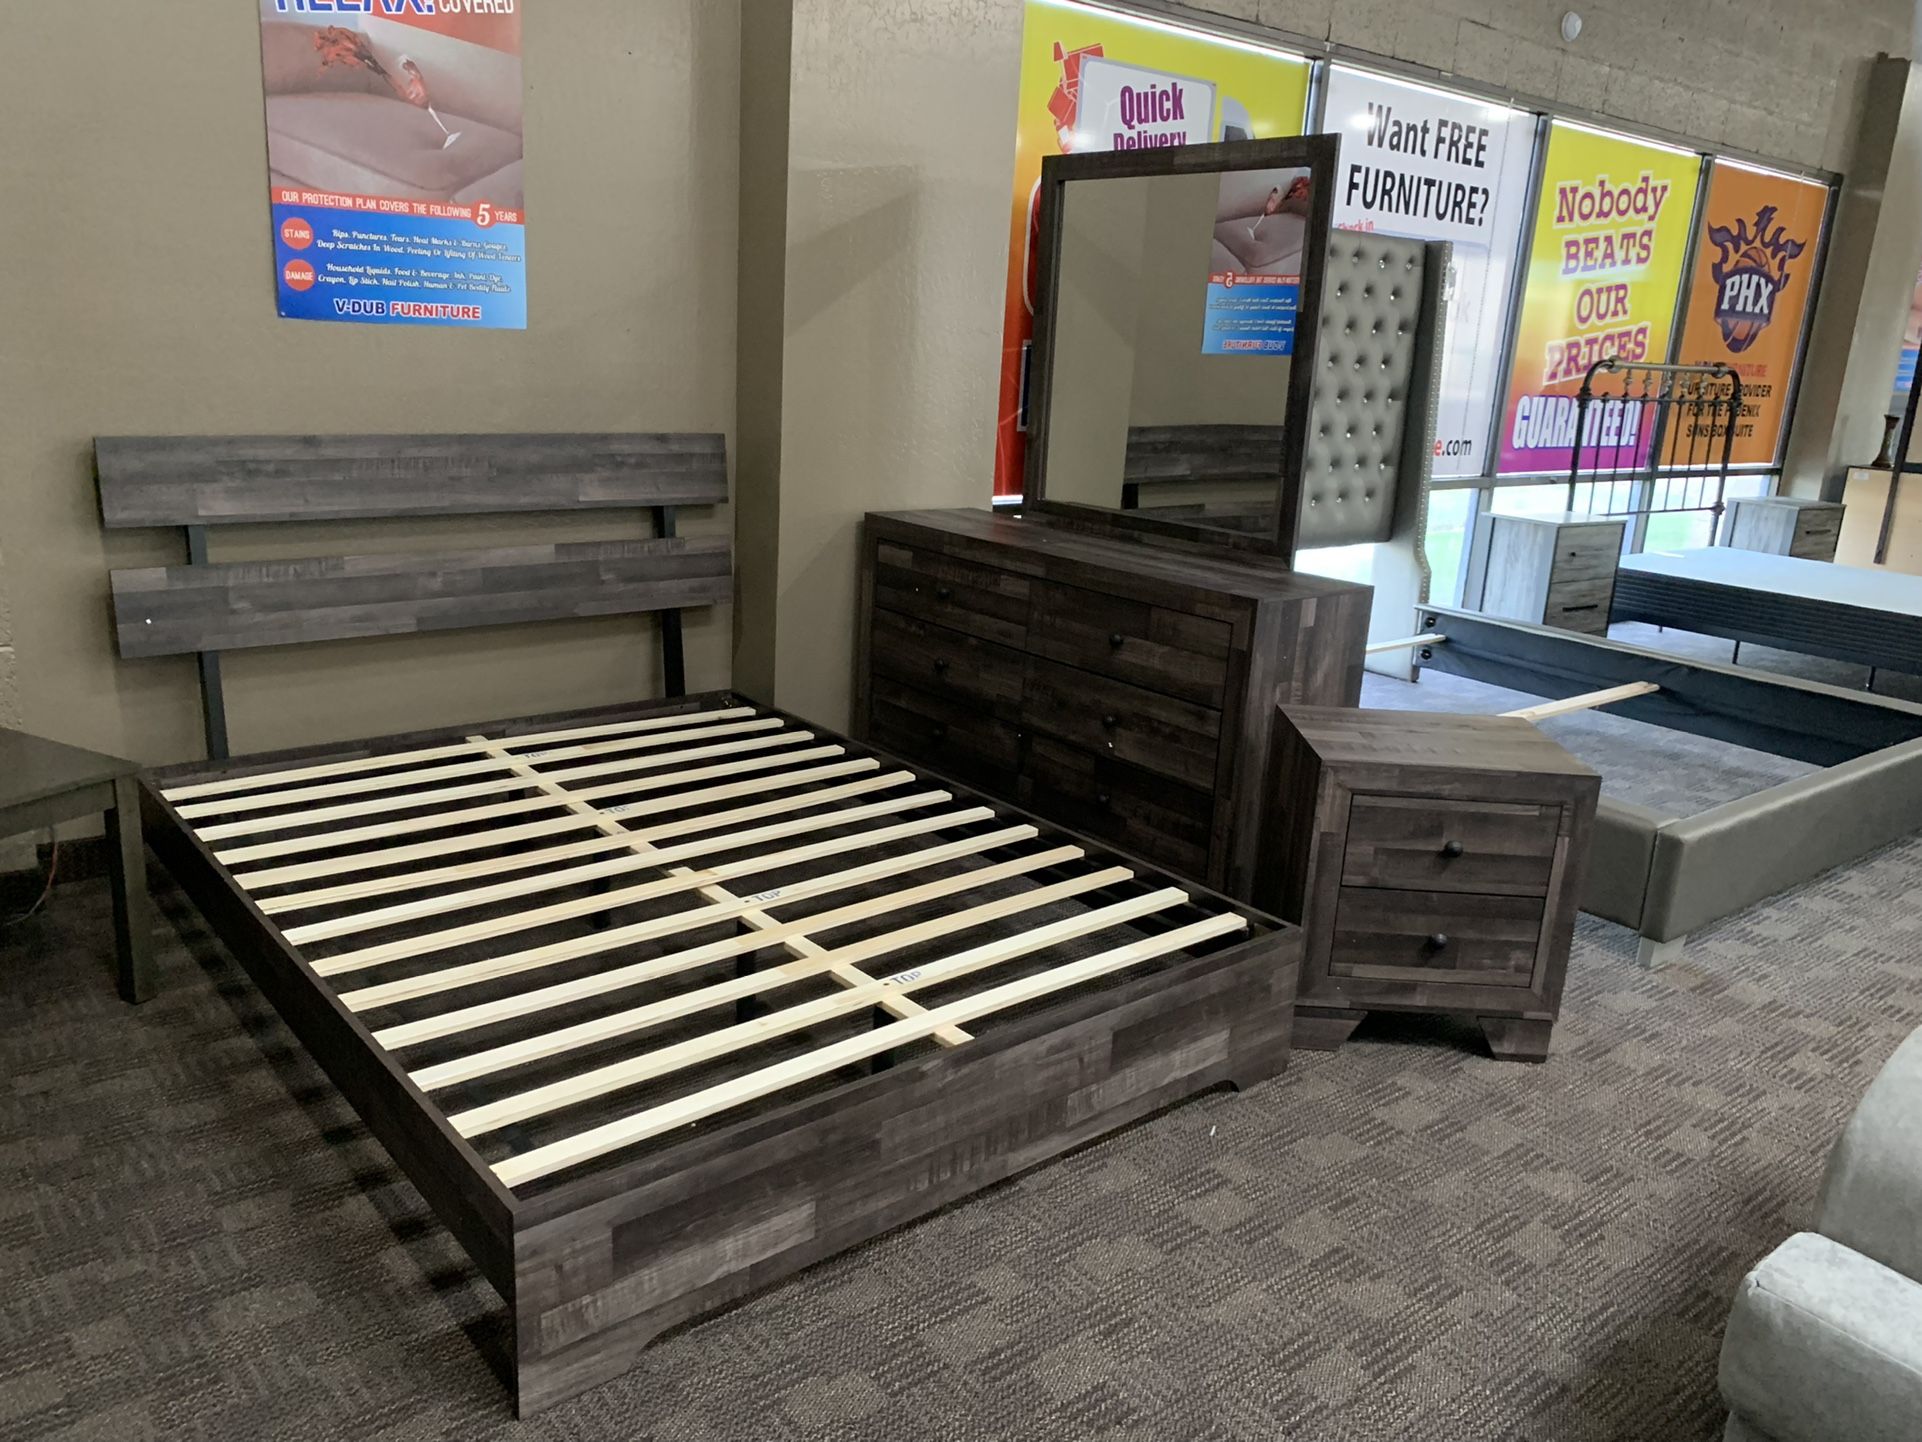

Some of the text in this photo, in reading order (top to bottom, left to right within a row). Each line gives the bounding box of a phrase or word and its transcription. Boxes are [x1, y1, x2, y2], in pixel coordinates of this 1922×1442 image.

[1120, 82, 1184, 130] Quick
[1367, 102, 1489, 169] Want FREE
[281, 190, 518, 226] OUR PROTECTION PLAN COVERS THE FOLLOWING 5 YEARS
[1346, 164, 1490, 227] FURNITURE?
[1556, 175, 1669, 223] Nobody
[284, 228, 310, 239] STAINS
[317, 239, 335, 251] Deep
[336, 240, 371, 252] Scratches
[1561, 229, 1653, 275] BEATS
[285, 270, 313, 281] DAMAGE
[325, 262, 364, 274] Household
[394, 267, 411, 277] Food
[334, 297, 482, 320] V-DUB FURNITURE
[1576, 283, 1628, 324] OUR
[1720, 273, 1774, 314] PHX
[1545, 324, 1650, 383] PRICES
